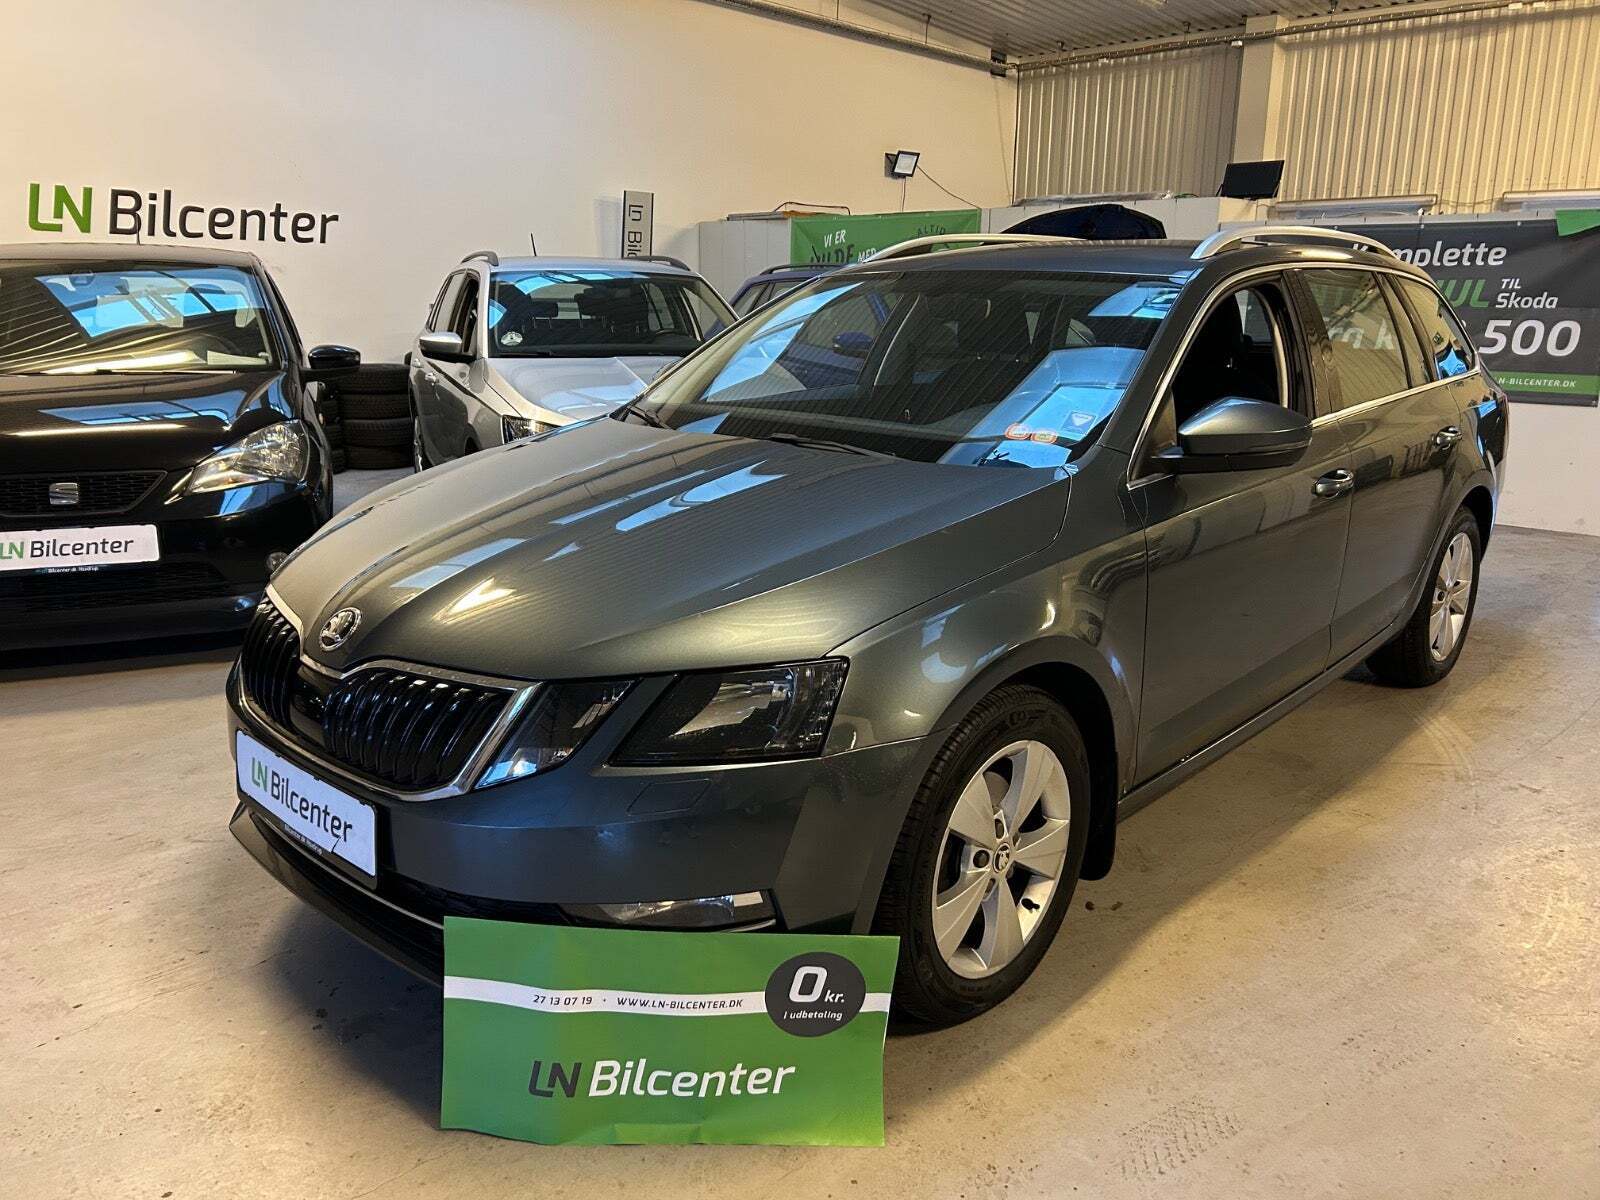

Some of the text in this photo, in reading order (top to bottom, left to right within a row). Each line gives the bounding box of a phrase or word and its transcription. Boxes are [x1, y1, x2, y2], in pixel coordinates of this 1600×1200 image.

[28, 183, 340, 245] LN Bilcenter
[823, 229, 847, 248] VI ER
[1352, 240, 1507, 267] mplette
[1501, 278, 1522, 290] TIL
[1495, 291, 1559, 309] Skoda
[1498, 377, 1577, 389] N-BILCENTER.DK
[0, 538, 134, 560] LN Bilcenter
[251, 756, 269, 793] LN
[271, 769, 353, 842] Bilcenter
[789, 966, 845, 1003] 0 kr.
[533, 994, 744, 1010] 27 13 07 19 WWW.LN-BILCENTER.DK
[790, 1010, 843, 1021] udbetaling
[528, 1057, 796, 1099] LN Bilcenter
